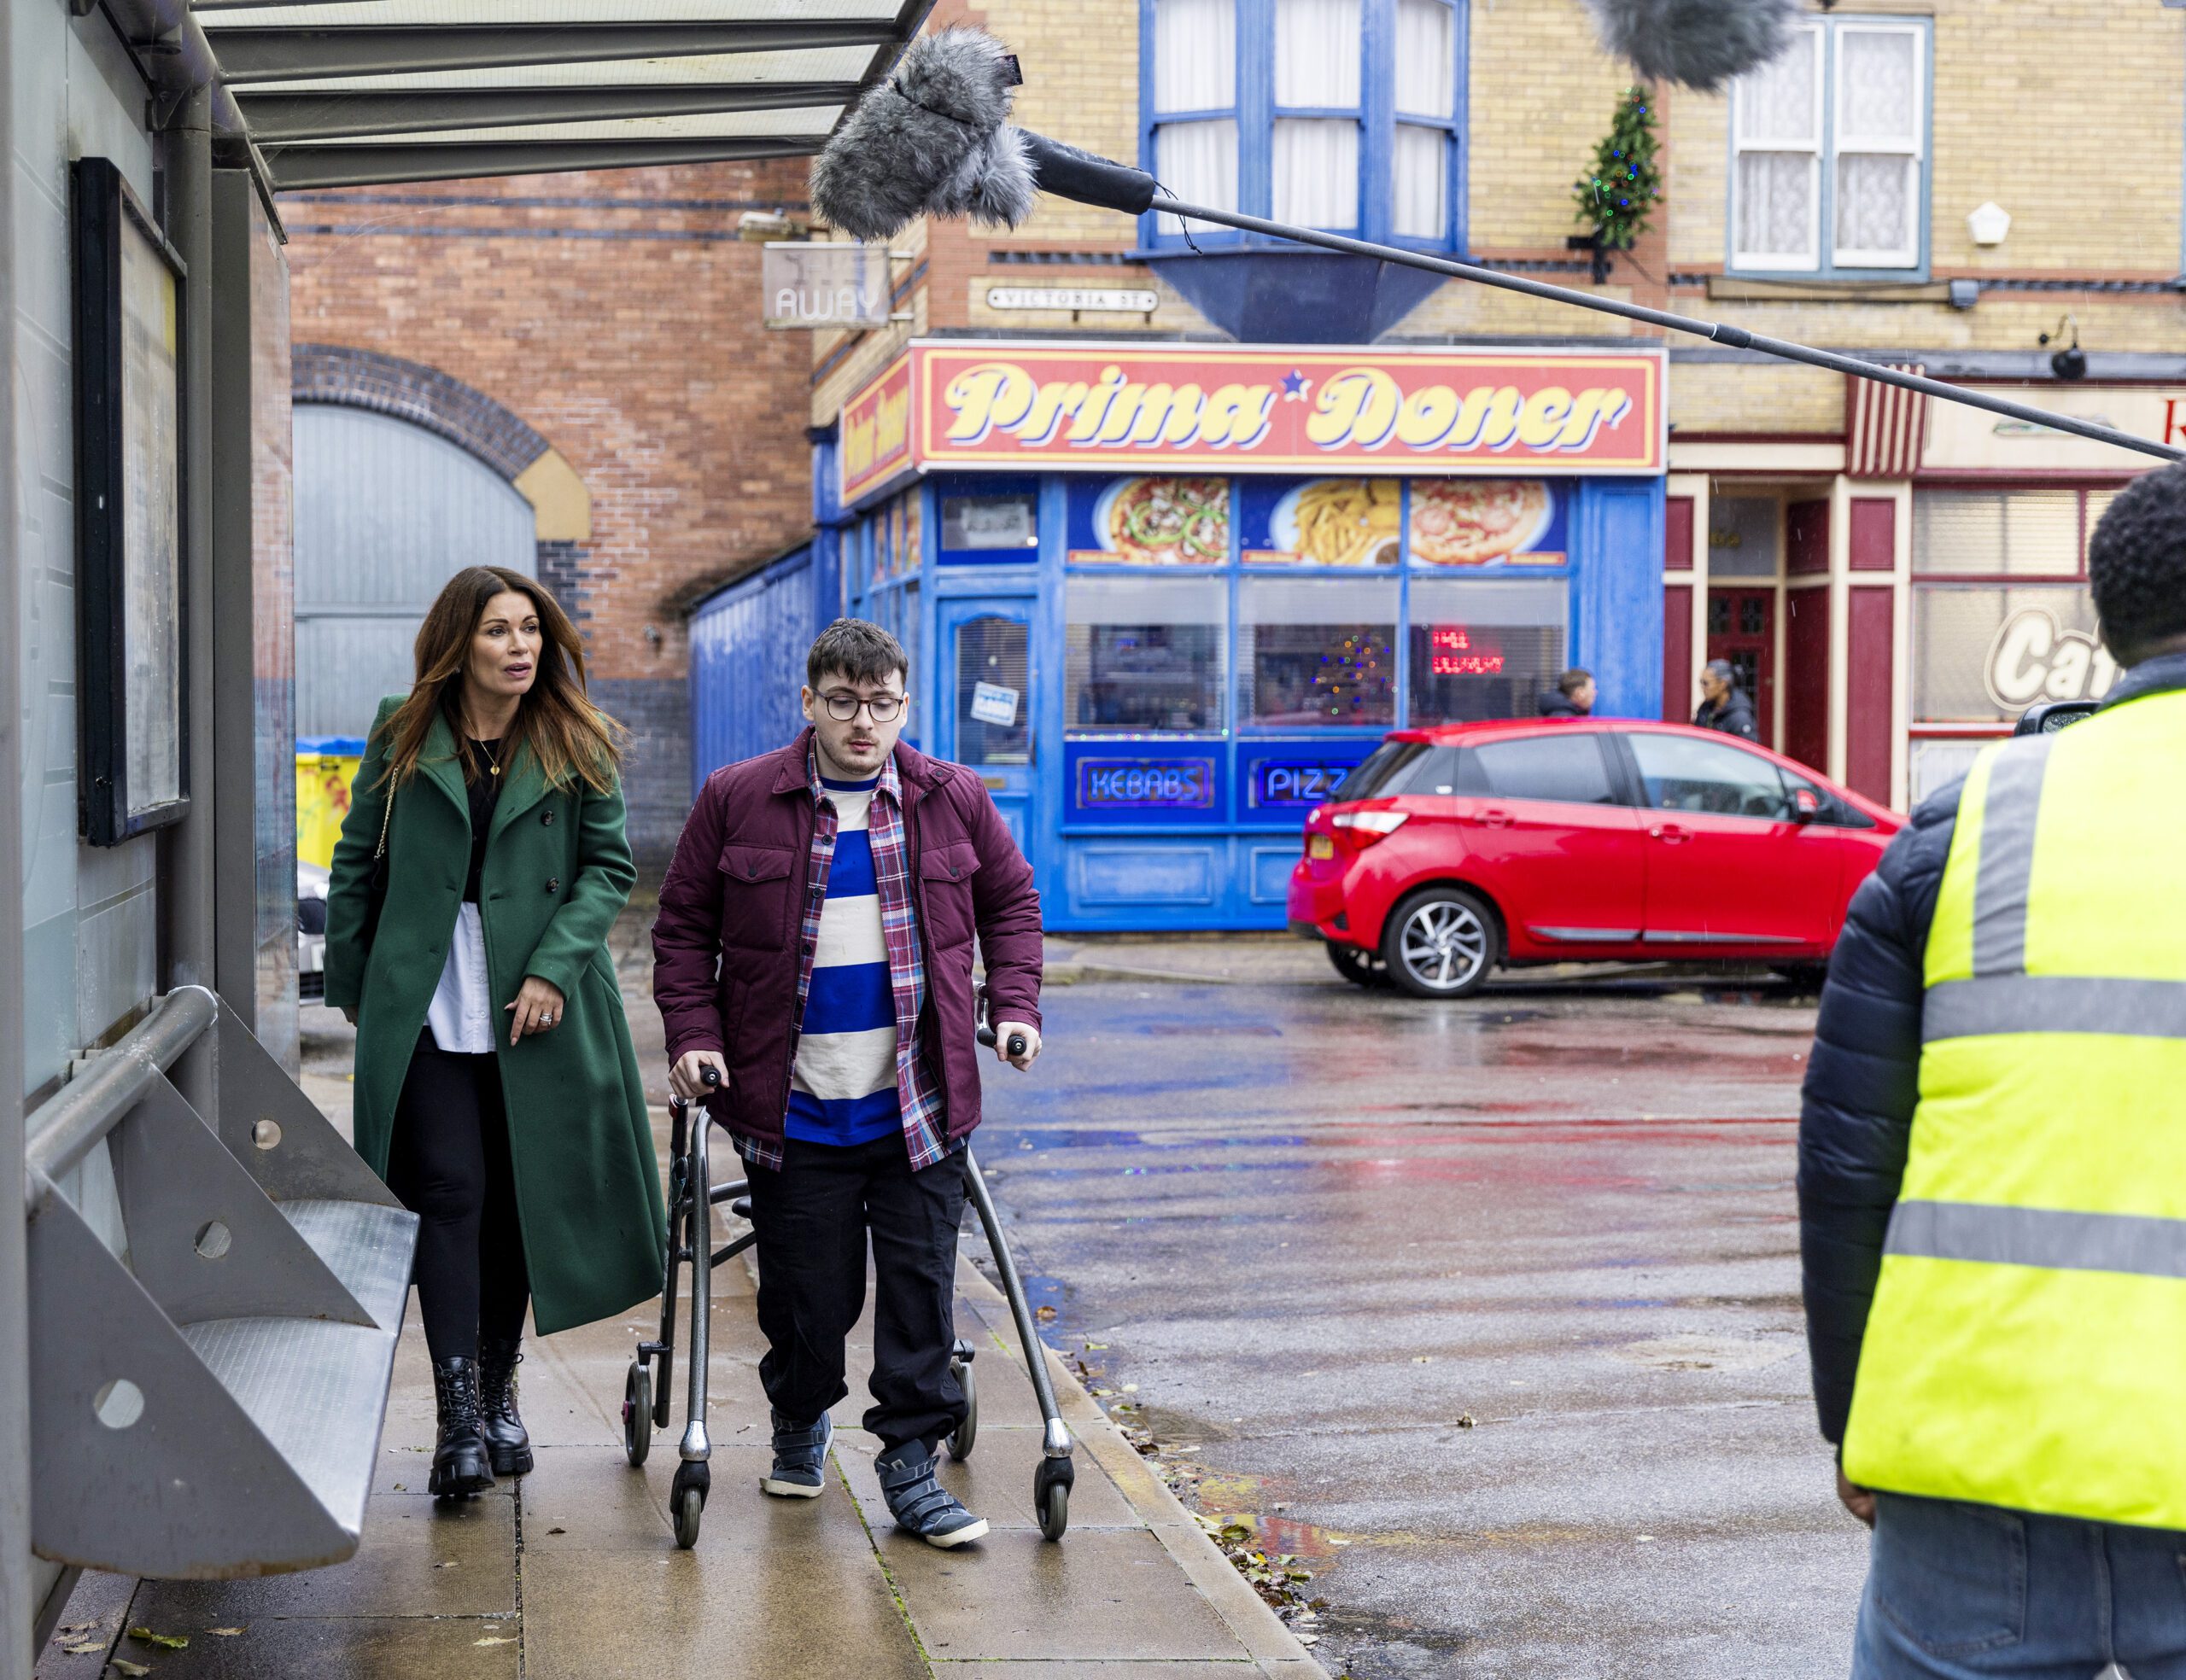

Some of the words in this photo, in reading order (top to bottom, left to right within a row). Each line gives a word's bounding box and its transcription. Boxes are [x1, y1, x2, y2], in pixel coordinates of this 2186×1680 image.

[775, 287, 880, 321] AWAY
[1005, 289, 1107, 307] VICTORIA
[944, 362, 1279, 451] Prima
[1306, 366, 1633, 453] Doner
[1994, 614, 2126, 701] Caf
[1091, 768, 1200, 800] KEBABS
[1268, 768, 1348, 799] PIZZ
